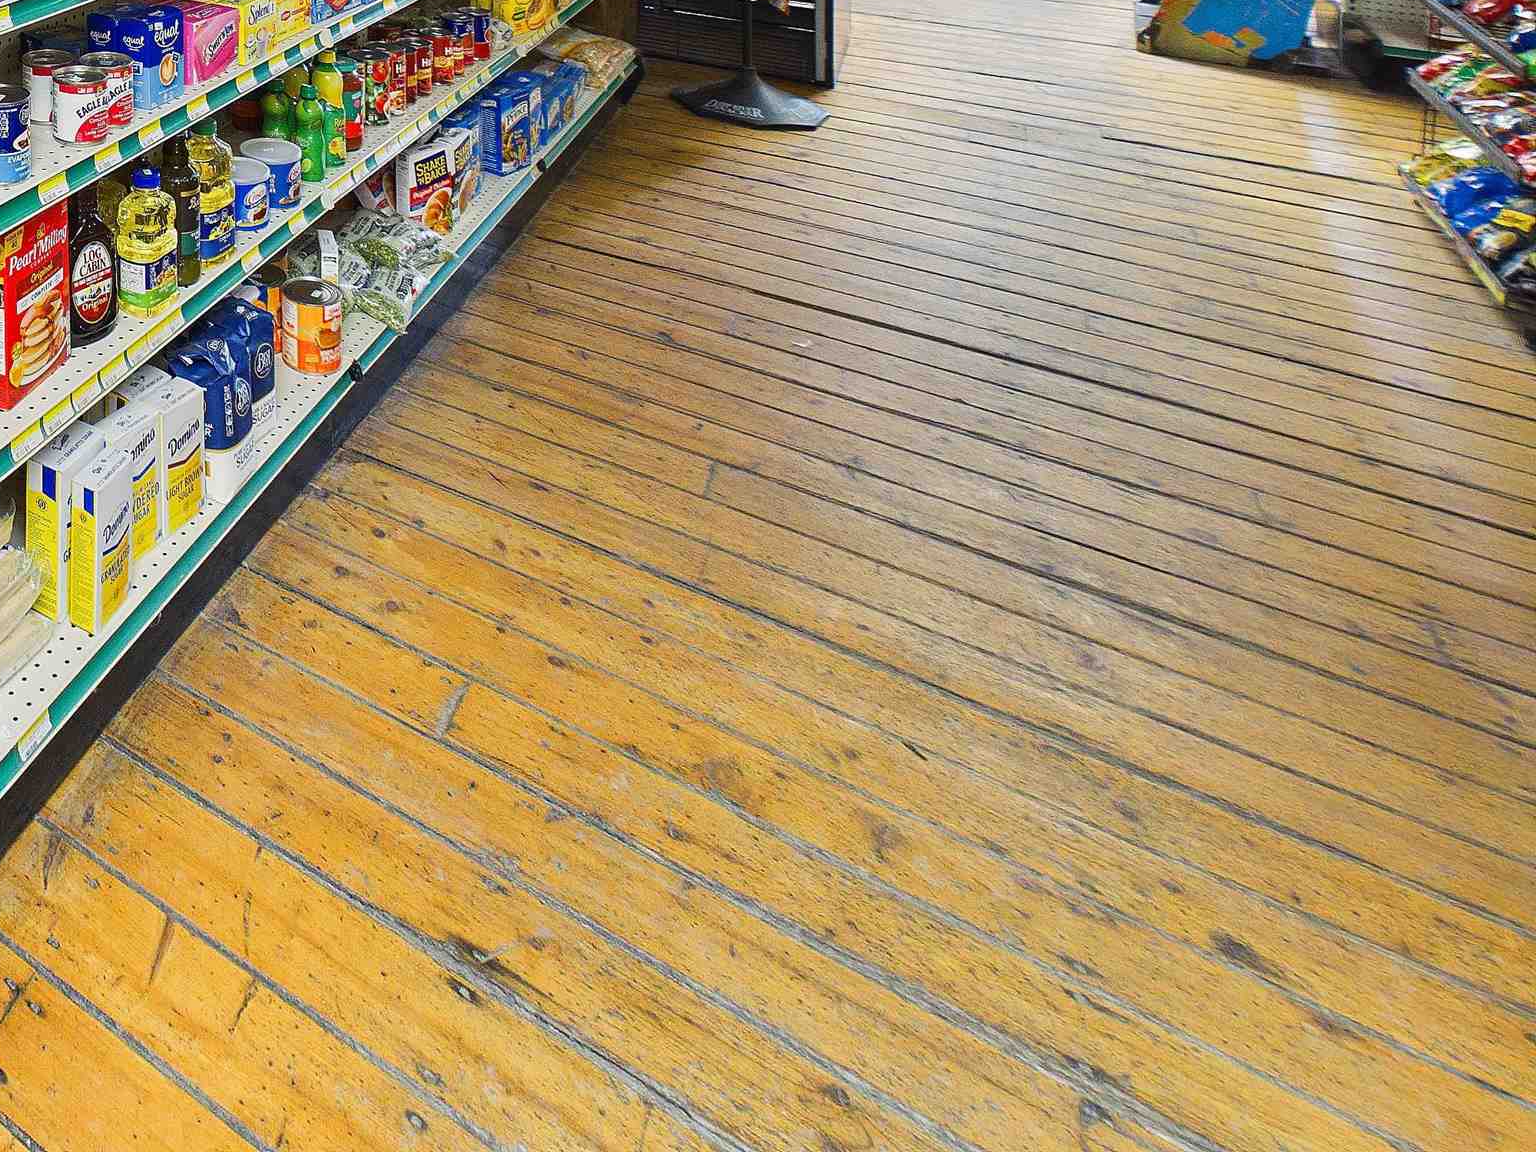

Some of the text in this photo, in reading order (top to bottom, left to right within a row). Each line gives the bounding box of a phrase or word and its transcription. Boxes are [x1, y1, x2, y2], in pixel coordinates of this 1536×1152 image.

[90, 30, 112, 44] equal
[154, 19, 180, 44] equal
[122, 35, 145, 49] equal
[76, 99, 101, 119] EAGLE
[416, 154, 446, 177] SHAKE
[425, 166, 447, 185] BAKE
[8, 225, 68, 277] Pearl Milling
[83, 246, 102, 263] LOG
[79, 257, 107, 277] CABIN
[167, 419, 200, 457] Domino
[166, 481, 184, 500] LIGHT
